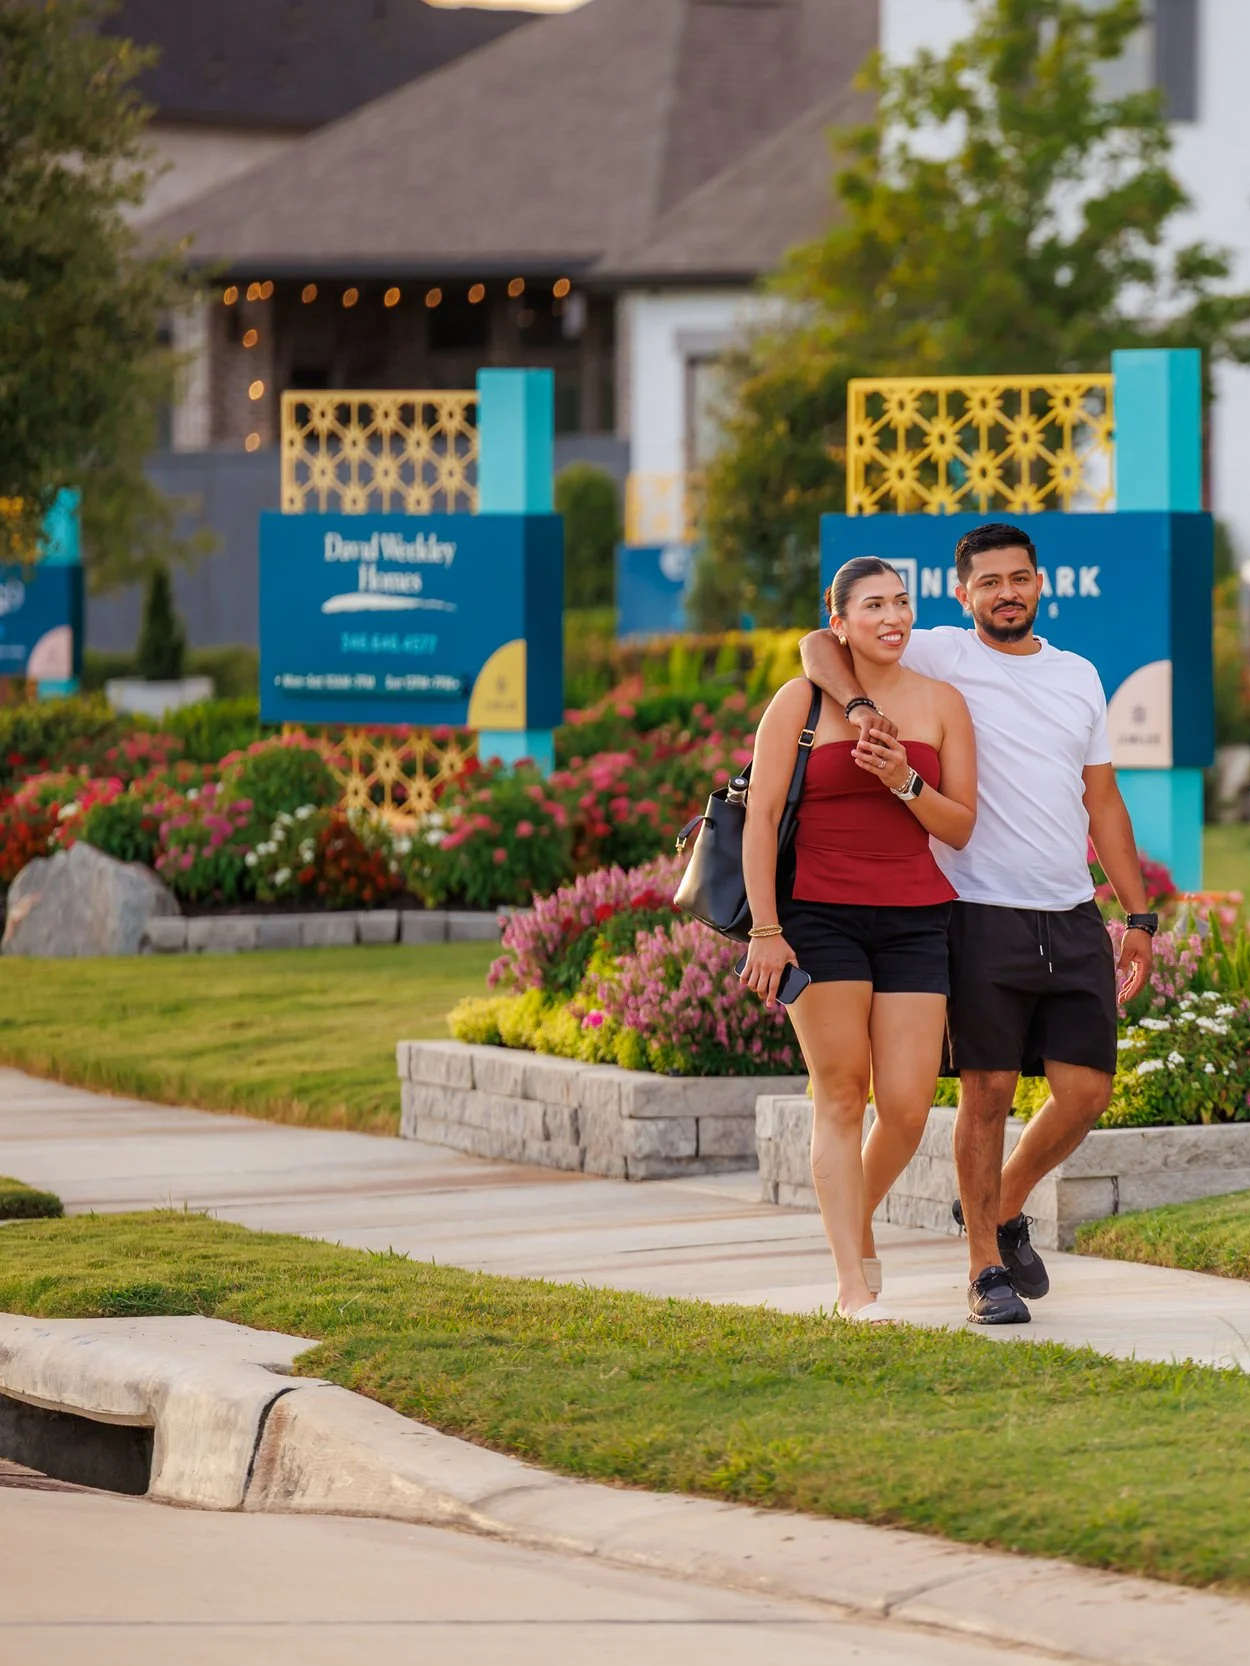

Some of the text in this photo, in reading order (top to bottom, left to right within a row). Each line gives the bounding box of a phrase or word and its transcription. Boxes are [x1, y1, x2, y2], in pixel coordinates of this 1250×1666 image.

[324, 531, 457, 569] David Weekley
[358, 563, 423, 593] Homes
[921, 567, 1101, 597] NEARK
